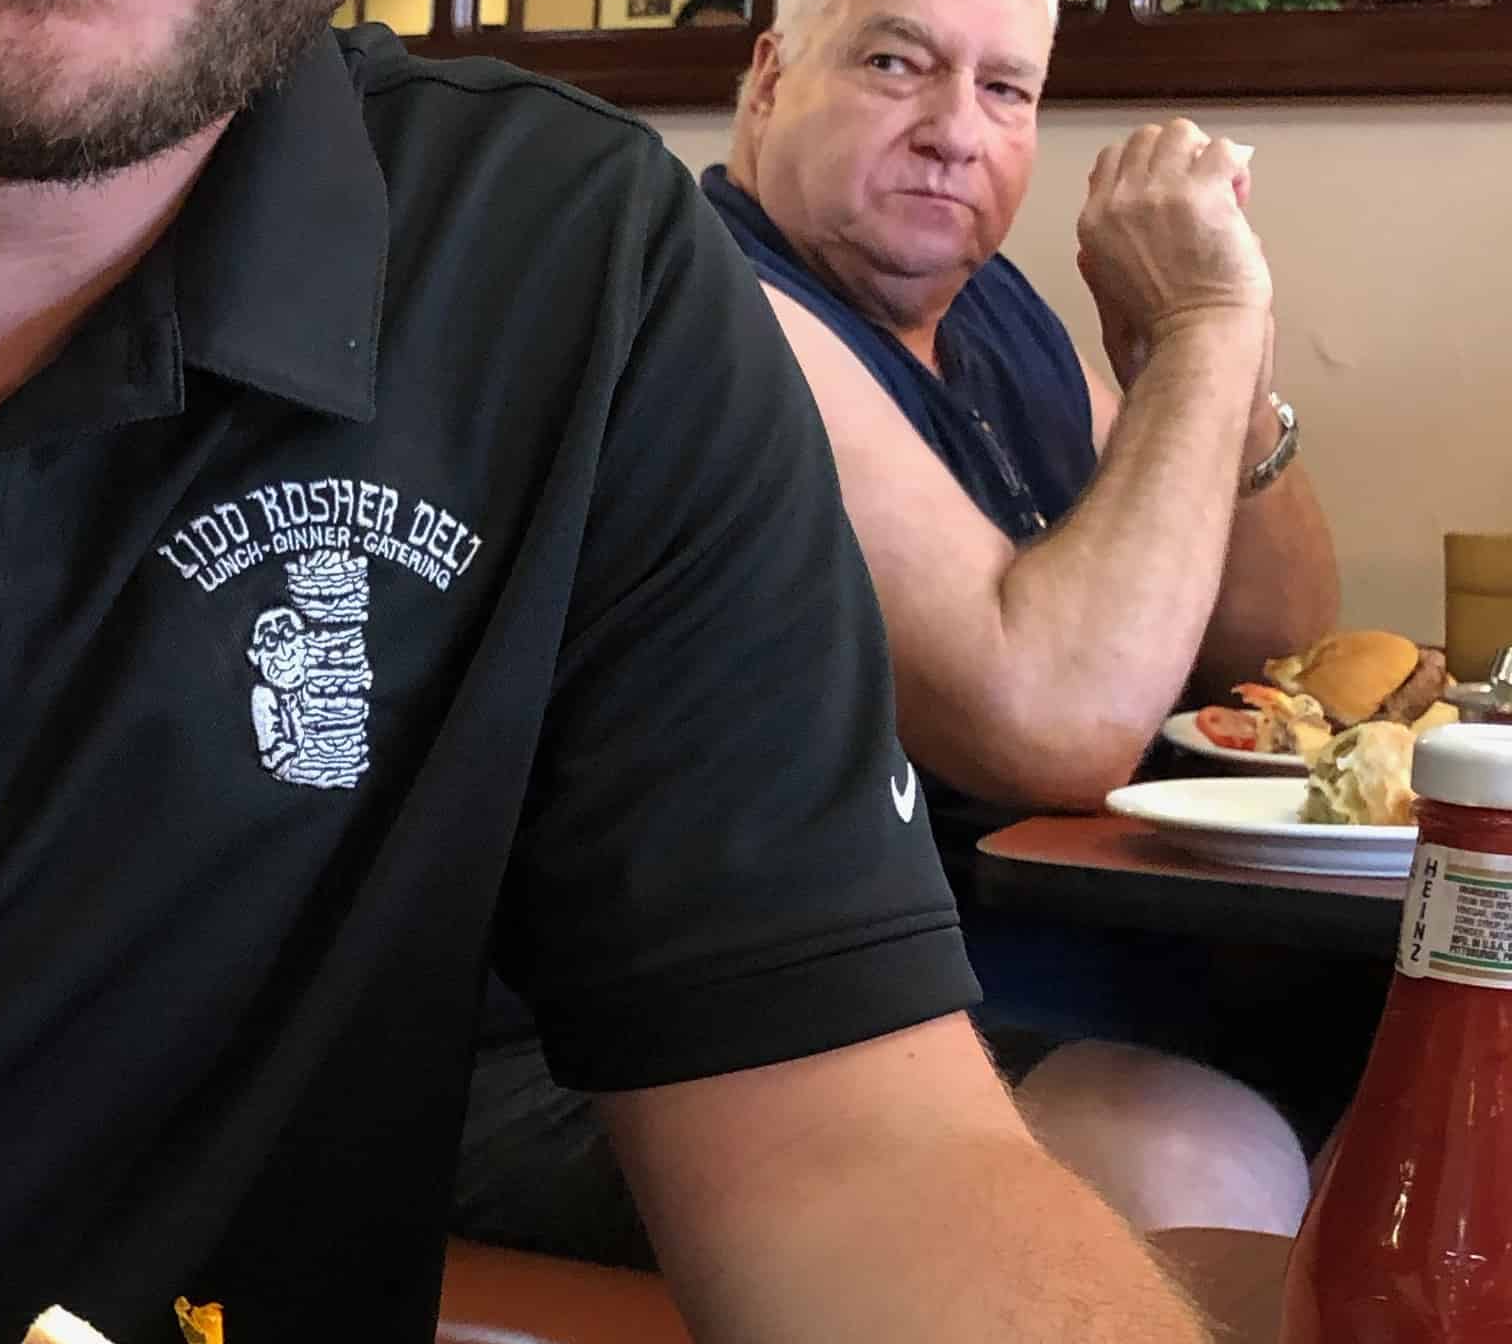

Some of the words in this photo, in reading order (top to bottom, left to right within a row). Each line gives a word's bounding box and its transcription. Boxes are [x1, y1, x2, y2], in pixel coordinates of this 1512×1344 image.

[157, 503, 250, 578] LIDO
[245, 477, 399, 533] KOSHER
[407, 498, 483, 576] DELI
[196, 541, 264, 592] LUNCH
[272, 526, 351, 554] DINNER
[1410, 857, 1439, 962] HEINZ
